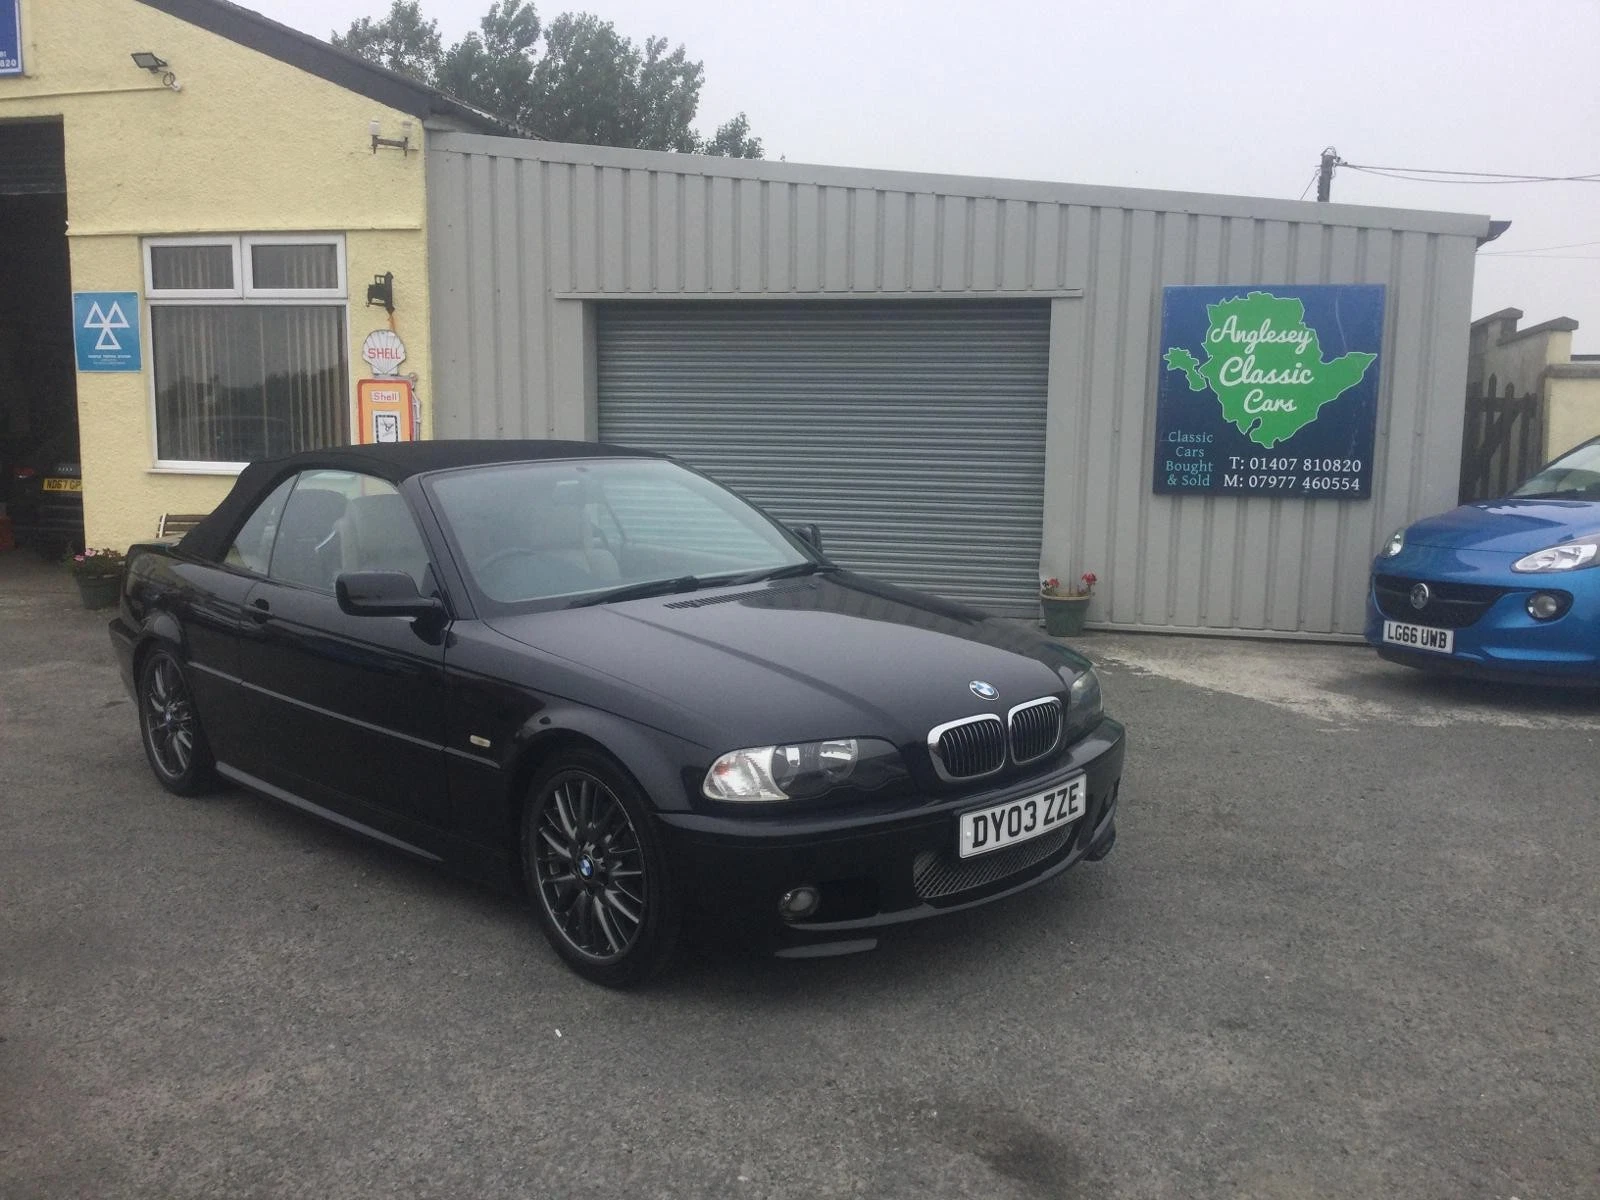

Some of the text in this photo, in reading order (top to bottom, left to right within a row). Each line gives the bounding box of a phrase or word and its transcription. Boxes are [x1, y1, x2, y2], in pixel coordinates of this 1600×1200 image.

[1211, 315, 1313, 354] Anglesey
[368, 348, 401, 360] SHELL
[1219, 355, 1314, 387] Classic
[373, 392, 397, 401] Shell
[1243, 389, 1297, 414] Cars
[1168, 431, 1214, 443] Classic
[1175, 446, 1205, 457] Cars
[1166, 460, 1213, 475] Bought
[1229, 457, 1362, 472] T: 01407 810820
[1167, 474, 1210, 487] & Sold
[1223, 474, 1360, 491] M: 07977 460554
[1388, 623, 1447, 649] LG66 UWB
[972, 782, 1080, 848] DY03 ZZE
